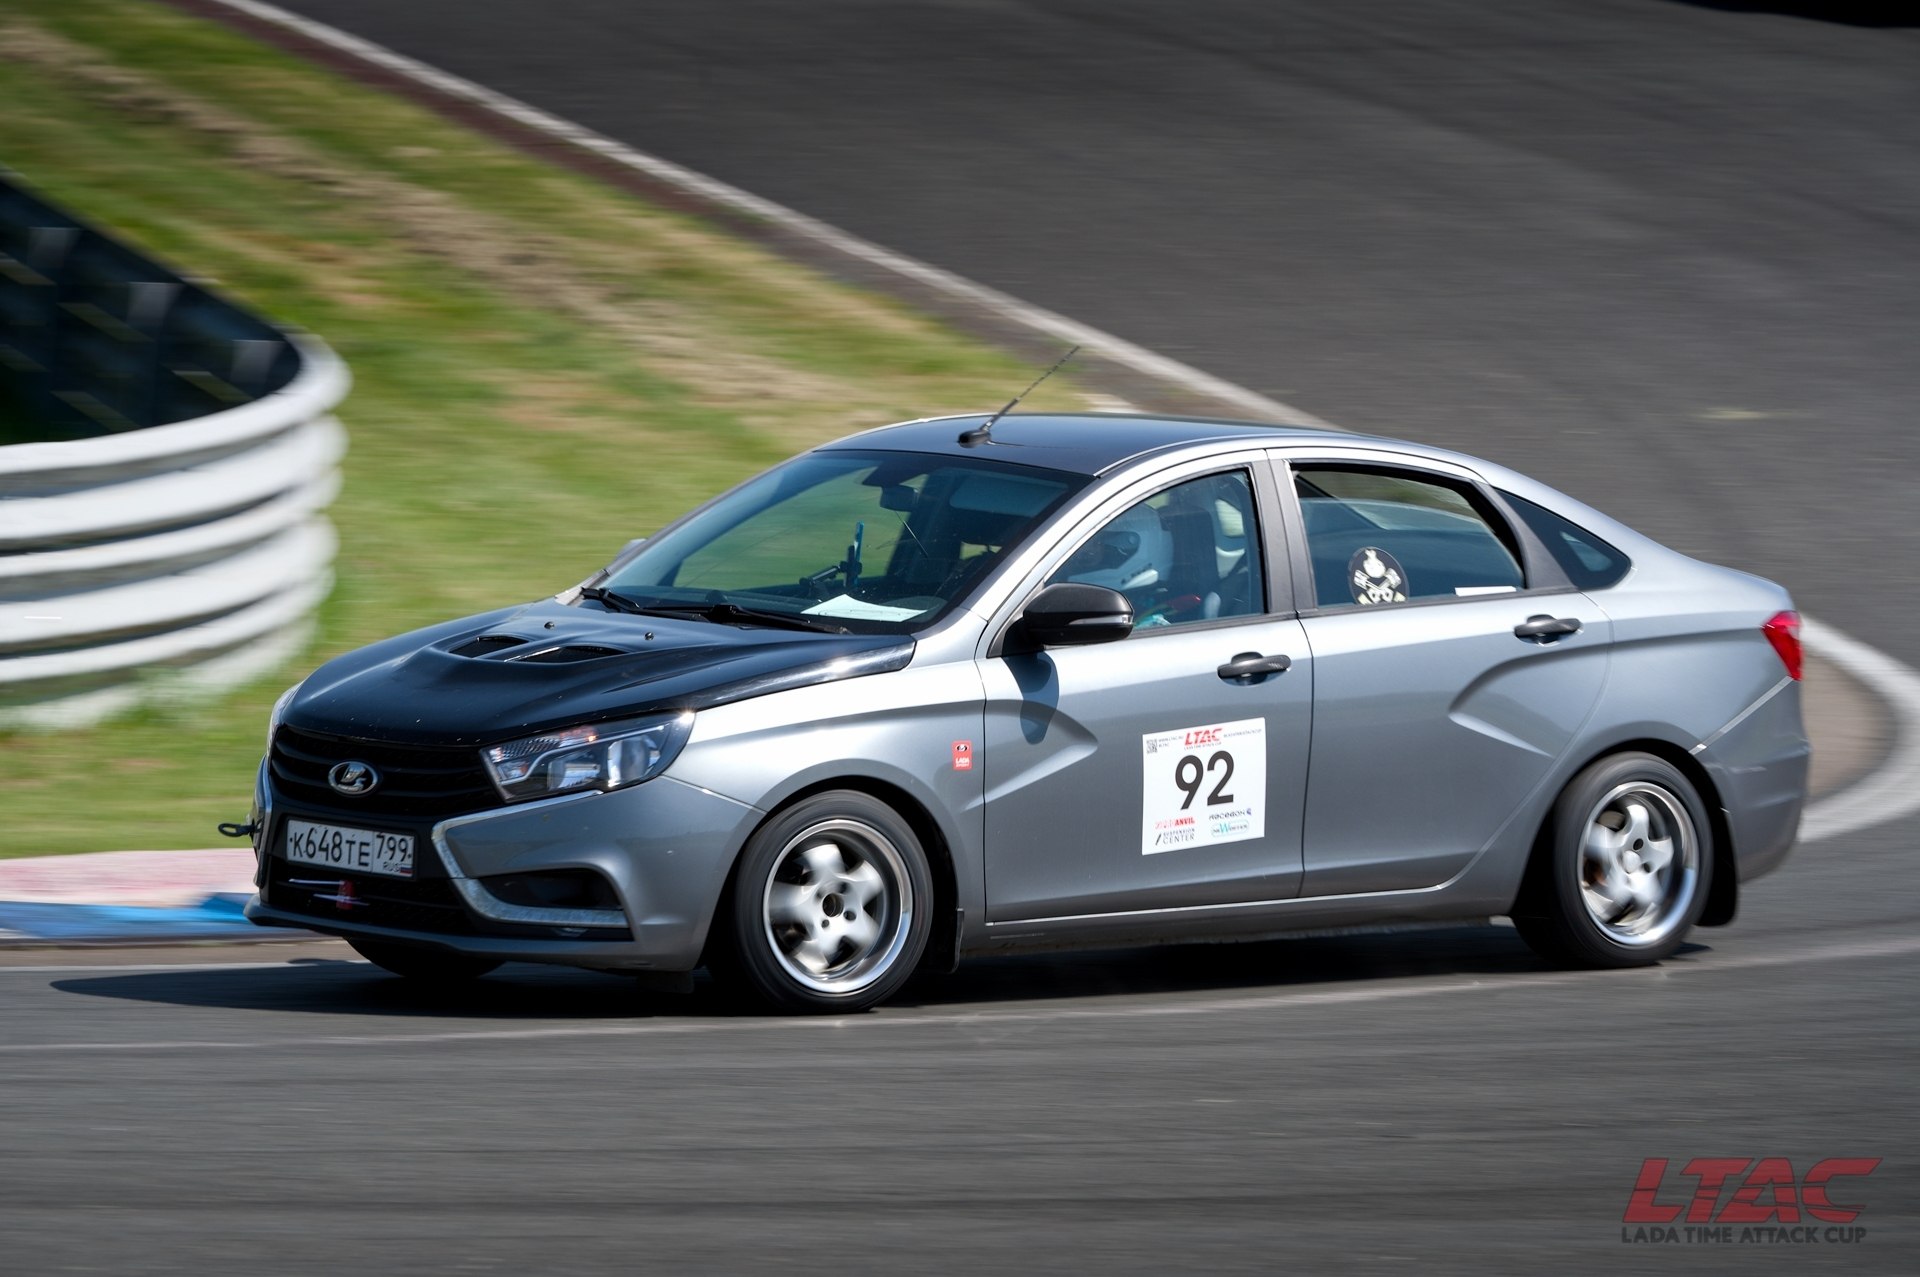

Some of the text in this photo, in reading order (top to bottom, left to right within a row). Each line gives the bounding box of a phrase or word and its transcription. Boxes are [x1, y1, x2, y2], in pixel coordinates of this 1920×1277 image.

[1184, 728, 1222, 745] LTAC
[1175, 750, 1234, 810] 92
[376, 834, 409, 862] 799
[1162, 833, 1196, 845] CENTER
